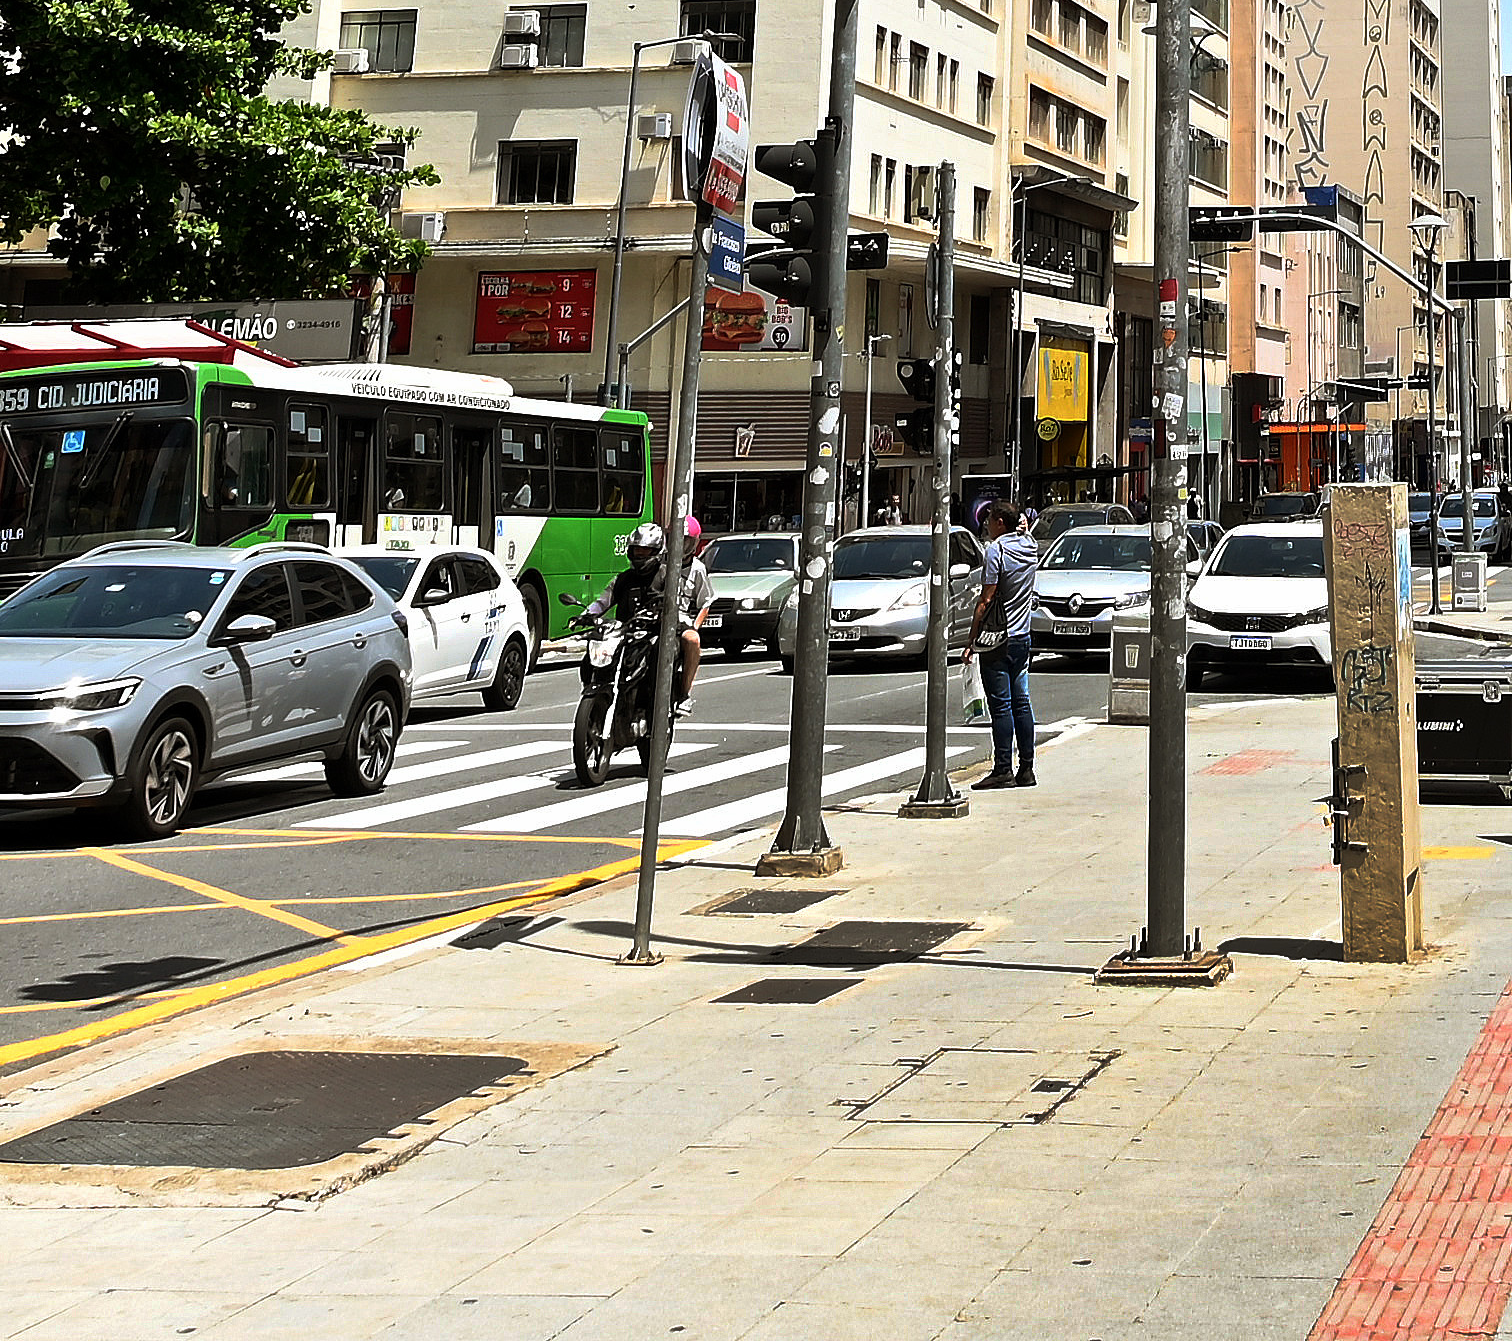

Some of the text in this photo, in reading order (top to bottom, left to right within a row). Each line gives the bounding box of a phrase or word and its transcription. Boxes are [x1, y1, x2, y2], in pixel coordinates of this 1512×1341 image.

[487, 285, 509, 297] POR
[560, 305, 573, 319] 12
[558, 330, 570, 344] 14
[37, 386, 67, 409] CID.
[389, 539, 410, 549] TAXI
